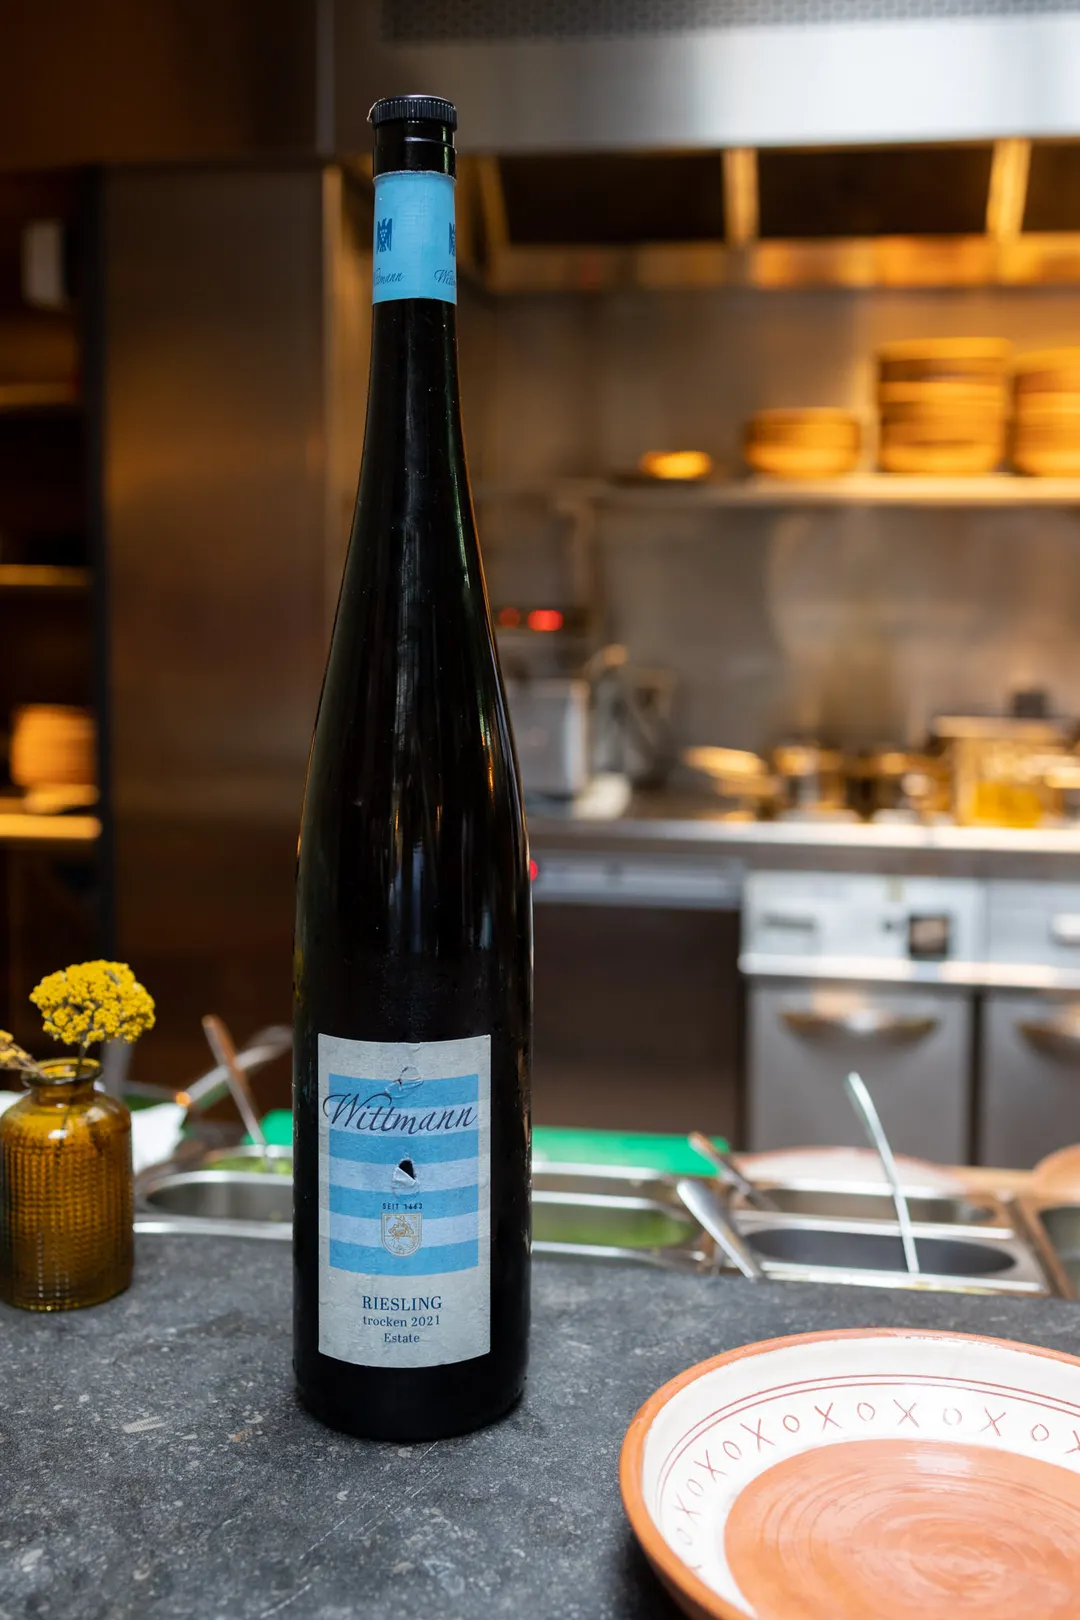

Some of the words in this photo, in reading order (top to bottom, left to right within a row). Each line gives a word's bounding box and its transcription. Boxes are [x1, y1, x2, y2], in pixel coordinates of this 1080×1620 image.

[323, 1093, 478, 1135] Wittmann
[382, 1202, 399, 1210] SEIT
[362, 1295, 442, 1311] RIESLING
[362, 1315, 408, 1328] trocken
[411, 1315, 440, 1327] 2021
[383, 1332, 421, 1344] Estate
